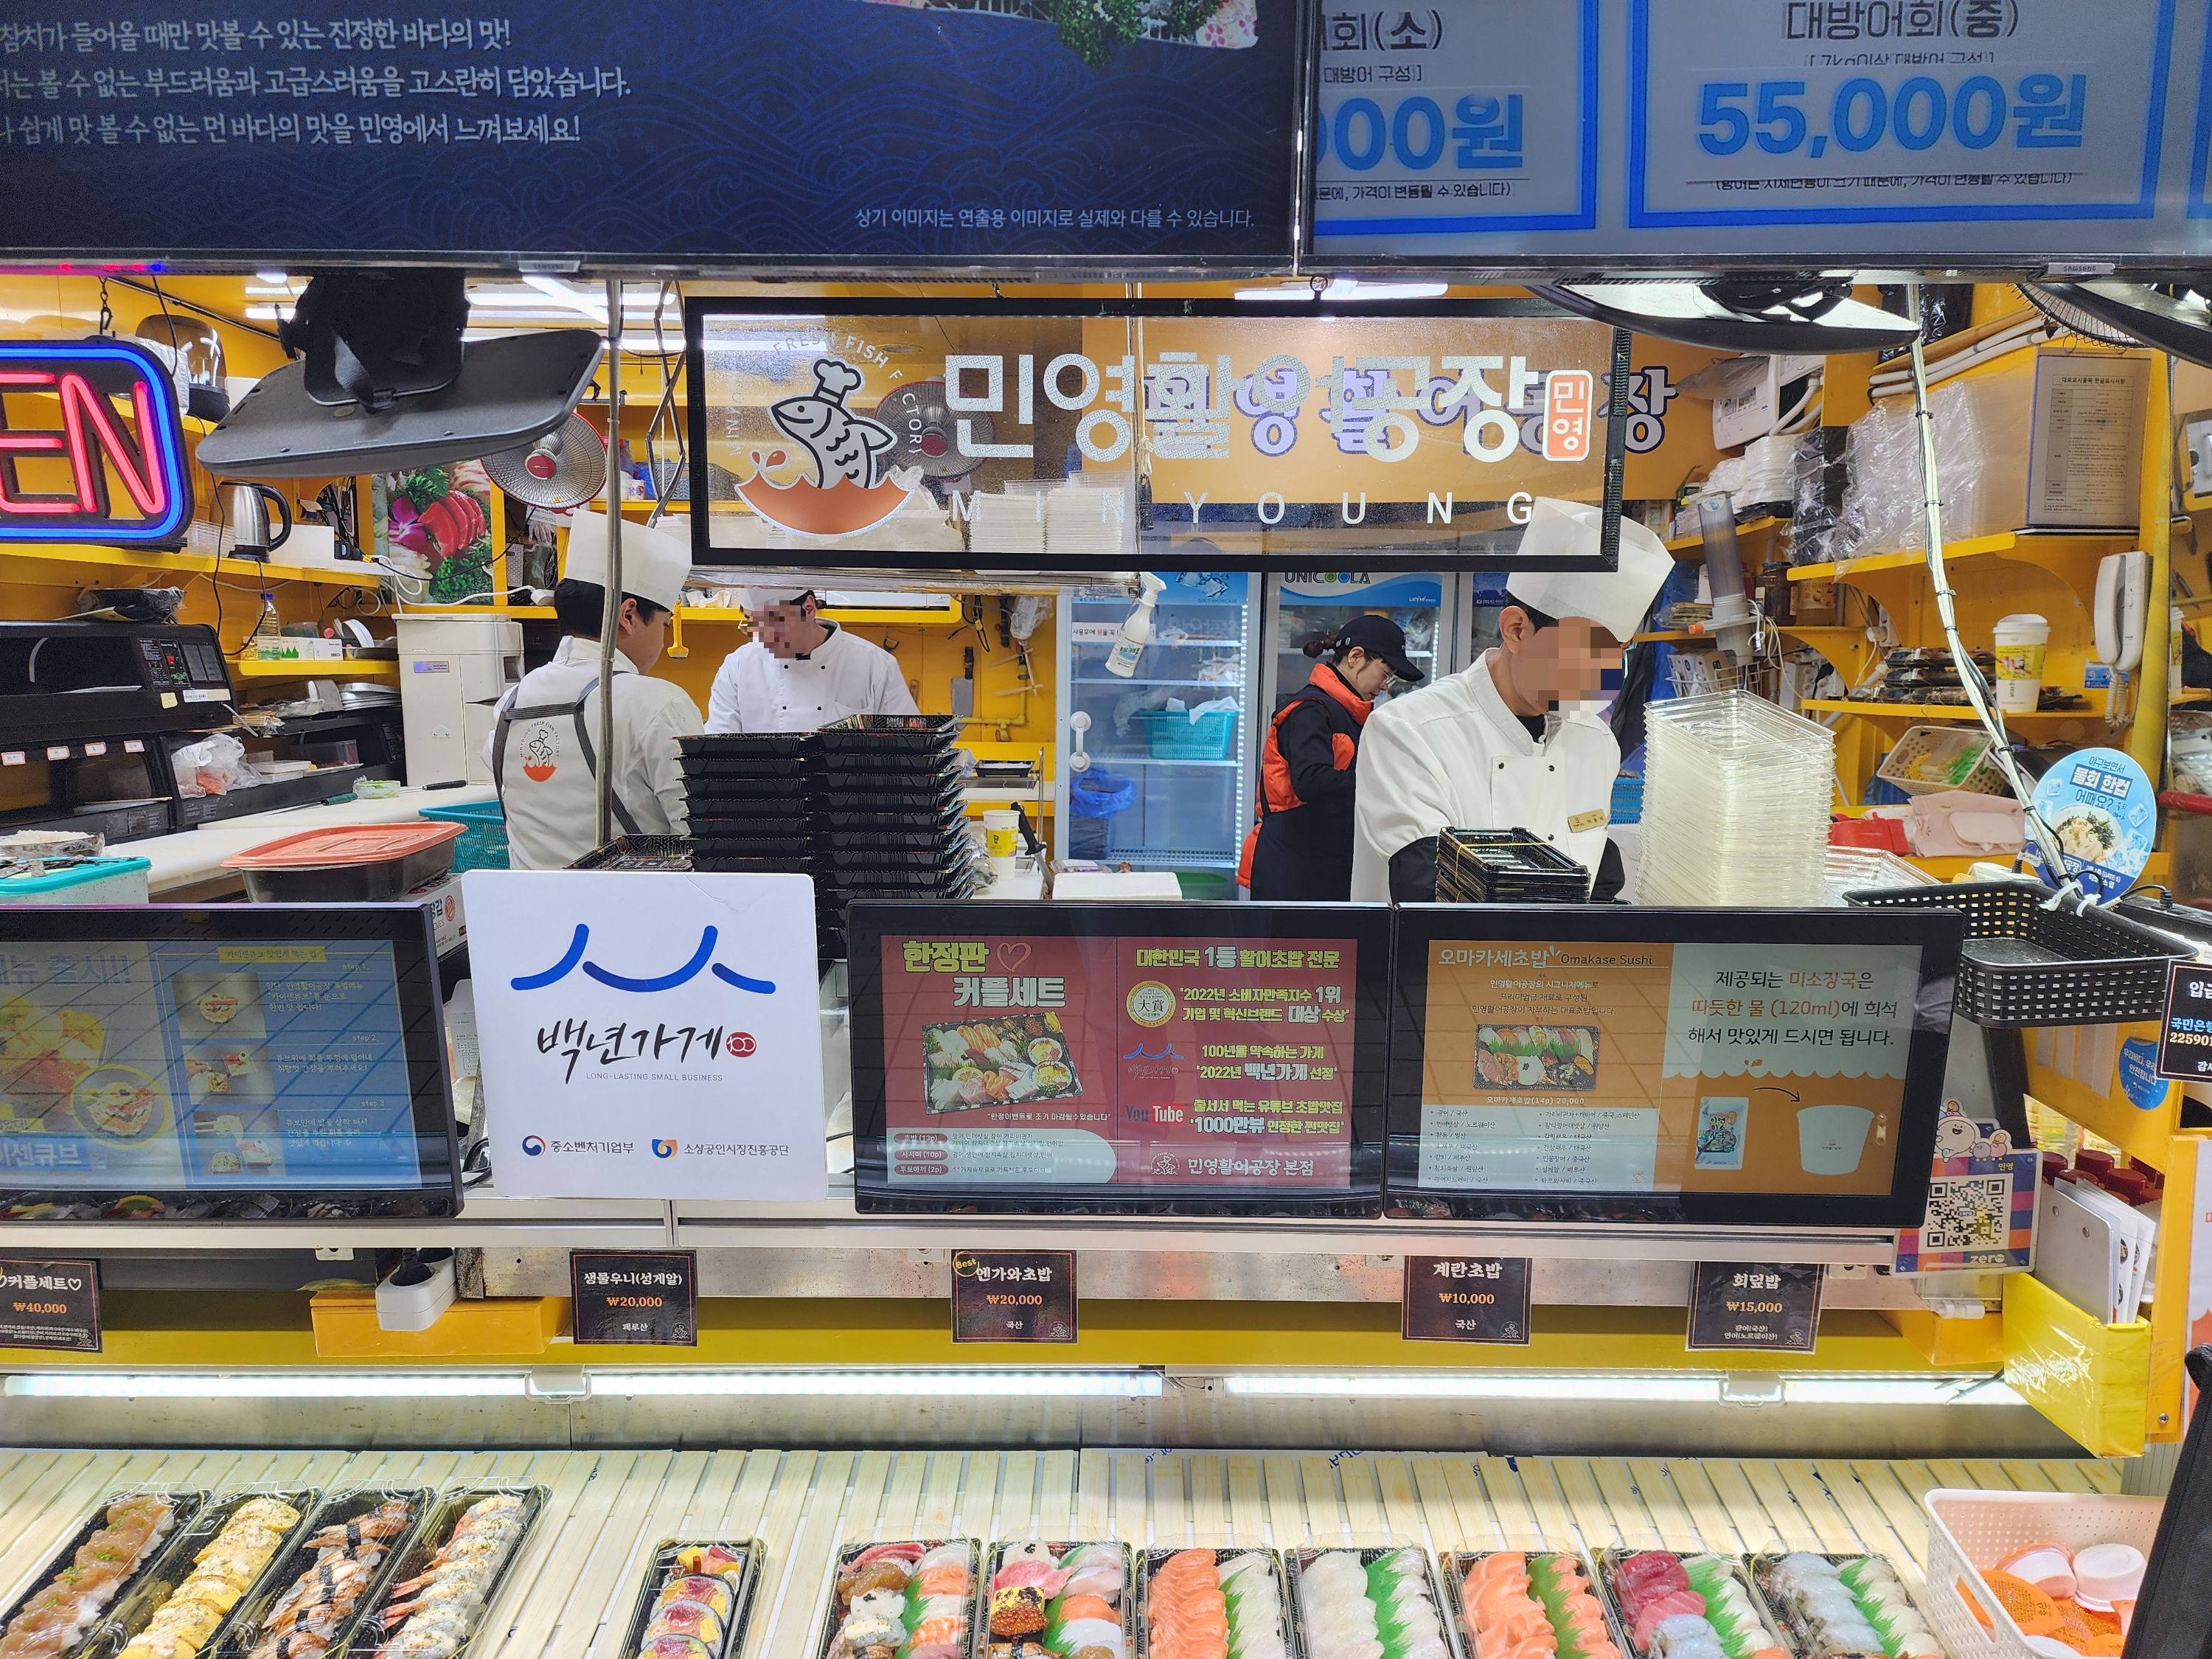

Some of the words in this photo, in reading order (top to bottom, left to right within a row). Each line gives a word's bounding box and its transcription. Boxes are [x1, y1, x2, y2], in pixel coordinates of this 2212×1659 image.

[1787, 0, 2019, 40] 대방어회(중)
[1, 21, 67, 54] 참치가
[72, 21, 140, 52] 들어올
[144, 20, 192, 50] 때만
[196, 19, 244, 50] 맛볼
[248, 20, 274, 49] 수
[276, 18, 326, 50] 있는
[328, 18, 399, 50] 진정한
[403, 18, 473, 50] 바다의
[479, 18, 511, 50] 맛!
[1322, 9, 1443, 52] 회(소)
[38, 69, 62, 99] 볼
[65, 69, 91, 97] 수
[93, 67, 142, 98] 없는
[146, 66, 260, 97] 부드러움과
[264, 66, 404, 98] 고급스러움을
[408, 66, 502, 98] 고스란히
[507, 66, 632, 98] 담았습니다.
[1324, 65, 1372, 83] 대방어
[1698, 72, 2087, 159] 55,000원
[18, 114, 64, 145] 쉽게
[69, 114, 92, 145] 맛
[96, 114, 122, 145] 볼
[125, 114, 150, 145] 수
[153, 114, 200, 144] 없는
[204, 113, 225, 144] 먼
[231, 113, 301, 145] 바다의
[306, 113, 355, 144] 맛을
[359, 113, 448, 145] 민영에서
[455, 113, 580, 145] 느껴보세요!
[1315, 94, 1523, 171] 00원
[1352, 184, 1391, 200] 가격이
[1437, 184, 1450, 198] 수
[1454, 182, 1511, 199] 있습니다)
[855, 209, 887, 227] 상기
[891, 209, 955, 228] 이미지는
[958, 209, 1006, 228] 연출용
[1011, 209, 1074, 228] 이미지로
[1077, 209, 1127, 228] 실제와
[1130, 209, 1161, 228] 다를
[1166, 209, 1183, 227] 수
[1186, 209, 1255, 228] 있습니다.
[846, 335, 889, 369] FISH
[945, 352, 1540, 463] 민영활어공장
[1552, 381, 1585, 452] 민영
[531, 720, 545, 729] FRESH
[546, 722, 555, 731] FISH
[2088, 756, 2126, 774] 야구보면서
[2071, 766, 2101, 789] 물회
[2100, 774, 2130, 799] 한컵
[2075, 788, 2114, 811] 어때요?
[902, 939, 990, 973] 한정판
[1136, 948, 1200, 967] 대한민국
[1203, 946, 1237, 969] 1등
[1239, 949, 1305, 968] 활어초밥
[1307, 950, 1340, 969] 전문
[1438, 948, 1549, 968] 오마카세초밥
[1560, 953, 1616, 964] Omakase
[1620, 954, 1653, 965] Sushi
[1490, 979, 1544, 989] 민영활어공장의
[1546, 980, 1599, 990] 시그니처메뉴로
[1715, 970, 1784, 989] 제공되는
[1790, 971, 1874, 990] 미소장국은
[953, 975, 1067, 1008] 커플세트
[1228, 988, 1312, 1003] 소비자만족지수
[1315, 986, 1342, 1004] 1위
[1500, 992, 1538, 1001] 프리미엄급
[1138, 999, 1164, 1012] 大賞
[1183, 1007, 1206, 1021] 기업
[1209, 1007, 1221, 1022] 및
[1223, 1007, 1284, 1022] 혁신브랜드
[1288, 1005, 1321, 1023] 대상
[1472, 1005, 1526, 1015] 민영활어공장이
[1527, 1006, 1558, 1015] 자부하는
[1560, 1006, 1616, 1015] 대표초밥입니다.
[1691, 999, 1742, 1017] 따듯한
[1748, 1000, 1764, 1017] 물
[1770, 1000, 1859, 1019] (120ml)에
[1864, 1001, 1897, 1019] 희석
[1688, 1027, 1722, 1044] 해서
[1728, 1028, 1778, 1046] 맛있게
[1783, 1029, 1833, 1046] 드시면
[1840, 1029, 1894, 1047] 됩니다.
[538, 1018, 724, 1085] 백년가게
[1201, 1044, 1248, 1059] 100년을
[1250, 1045, 1298, 1060] 약속하는
[1299, 1046, 1324, 1060] 가게
[586, 1072, 648, 1081] LONG-LASTING
[651, 1073, 679, 1081] SMALL
[681, 1074, 723, 1082] BUSINESS
[1244, 1062, 1308, 1081] 백년가게
[1193, 1099, 1229, 1113] 줄서서
[1232, 1099, 1256, 1113] 먹는
[1258, 1100, 1293, 1113] 유튜브
[1295, 1100, 1343, 1114] 초밥맛집
[1486, 1096, 1554, 1105] 오마카세초밥(14p)
[1557, 1097, 1585, 1105] 20,000
[1034, 1113, 1050, 1121] 조기
[1267, 1120, 1303, 1133] 인정한
[919, 1134, 938, 1142] (13p)
[550, 1139, 635, 1155] 중소벤처기업부
[684, 1142, 790, 1157] 소상공인시장진흥공단
[923, 1151, 942, 1159] (10p)
[928, 1166, 942, 1174] (2p)
[1189, 1158, 1281, 1176] 민영활어공장
[1284, 1158, 1314, 1176] 본점
[1998, 1162, 2014, 1171] 민영
[956, 1258, 977, 1269] Best
[1433, 1262, 1503, 1279] 계란초밥
[583, 1272, 683, 1285] 생물우니(성게알)
[976, 1266, 1053, 1281] 엔가와초밥
[1733, 1273, 1781, 1290] 회덮밥
[13, 1302, 67, 1314] ₩40,000
[606, 1296, 663, 1307] ₩20,000
[987, 1295, 1043, 1306] ₩20,000
[1439, 1293, 1495, 1305] ₩10,000
[1726, 1301, 1783, 1313] ₩15,000
[622, 1323, 648, 1332] 페루산
[1006, 1321, 1023, 1329] 국산
[1455, 1319, 1477, 1330] 국산
